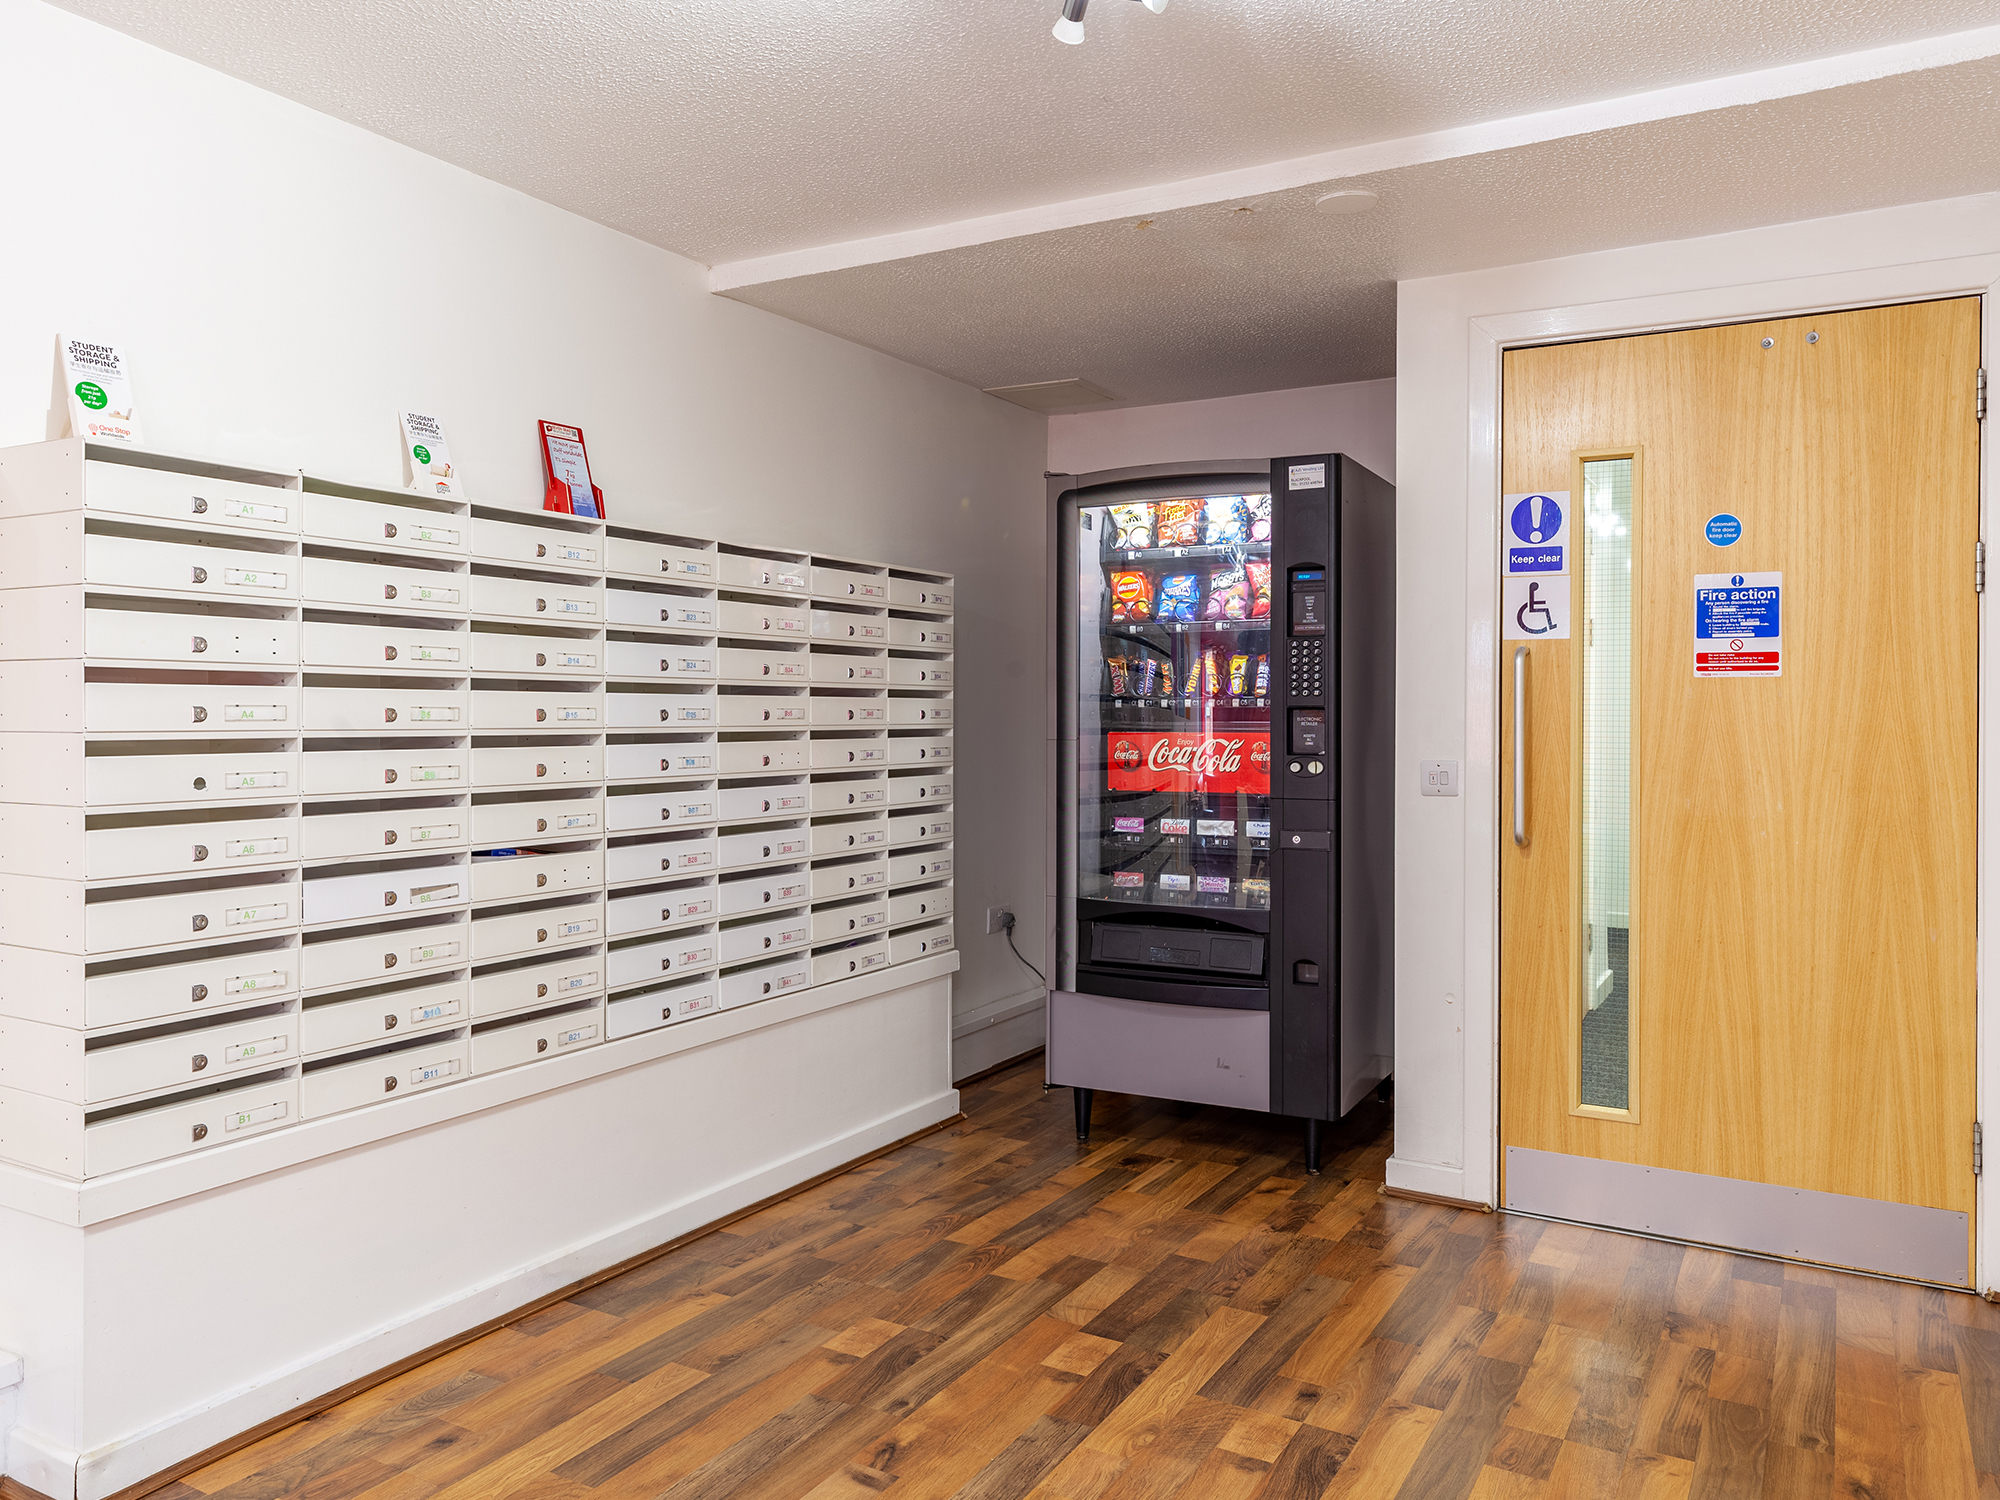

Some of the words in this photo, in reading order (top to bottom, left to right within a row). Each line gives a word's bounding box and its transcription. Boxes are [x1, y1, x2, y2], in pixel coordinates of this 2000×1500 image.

[72, 341, 113, 354] STUDENT
[69, 346, 111, 361] STORAGE
[74, 355, 117, 368] SHIPPING
[408, 413, 435, 423] STUDENT
[407, 419, 434, 429] STORAGE
[115, 427, 130, 436] Stop
[411, 425, 438, 435] SHIPPING
[565, 469, 569, 477] 7
[242, 505, 255, 515] A1
[421, 531, 432, 540] B2
[567, 551, 580, 559] B12
[1511, 555, 1535, 564] Keep
[1538, 554, 1561, 562] clear
[686, 564, 698, 573] B22
[244, 573, 257, 583] A2
[1118, 583, 1140, 591] WALKERS
[421, 590, 432, 599] B3
[1700, 590, 1727, 601] Fire
[1731, 588, 1776, 600] action
[565, 603, 579, 612] B13
[686, 613, 697, 621] B23
[421, 651, 432, 659] B4
[567, 657, 580, 665] B14
[686, 661, 697, 669] B24
[1111, 665, 1125, 694] TWIX
[241, 709, 255, 719] A4
[565, 711, 578, 719] B15
[1177, 738, 1194, 746] Enjoy
[1114, 750, 1139, 760] Coca-Cola
[1148, 738, 1244, 773] Coca-Cola
[241, 777, 256, 787] A5
[782, 799, 792, 807] B37
[1117, 819, 1139, 827] Coca-Cola
[1162, 822, 1188, 833] Coke
[421, 830, 432, 839] B7
[242, 845, 255, 855] A6
[687, 855, 698, 864] B28
[1116, 875, 1139, 884] Coca-Cola
[783, 889, 792, 897] B39
[420, 894, 432, 903] B8
[687, 905, 698, 914] B29
[243, 910, 257, 920] A7
[567, 924, 581, 934] B19
[782, 933, 792, 941] B40
[423, 949, 434, 958] B9
[687, 953, 698, 962] B30
[242, 979, 257, 990] A8
[570, 978, 583, 988] B20
[782, 978, 792, 986] B41
[689, 1001, 700, 1010] B31
[568, 1032, 581, 1042] B21
[242, 1046, 256, 1057] A9
[424, 1069, 439, 1080] B11
[238, 1113, 251, 1124] B1
